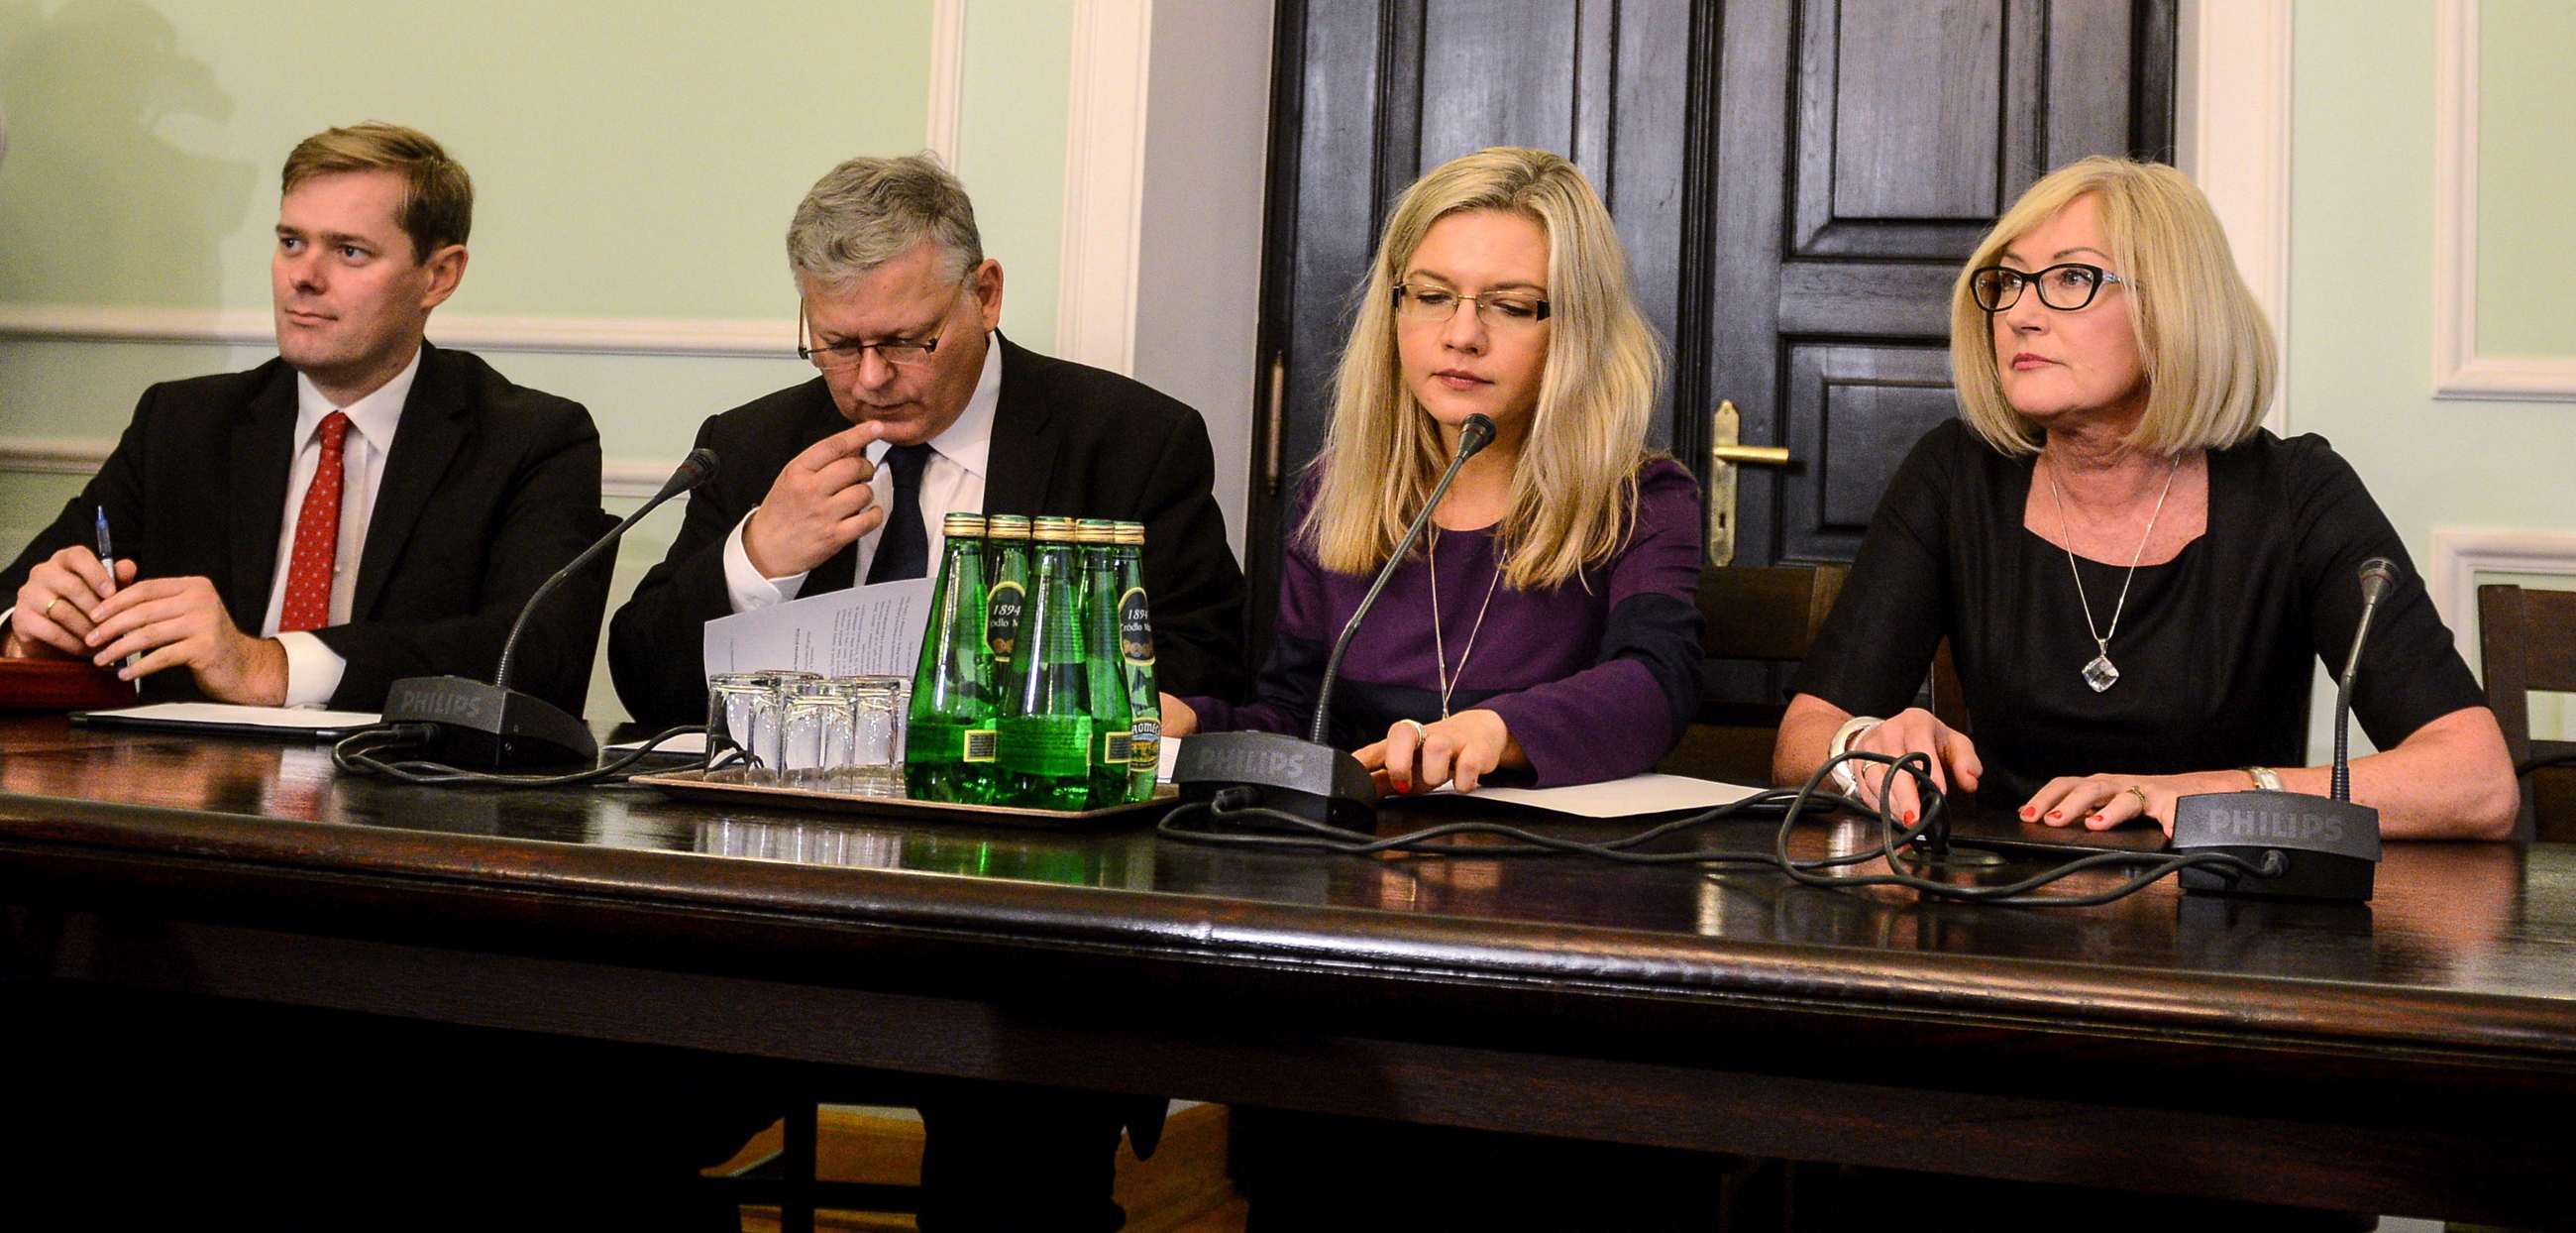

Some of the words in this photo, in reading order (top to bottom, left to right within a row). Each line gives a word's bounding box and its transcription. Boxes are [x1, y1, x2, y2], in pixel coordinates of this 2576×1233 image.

[994, 605, 1021, 616] 1894
[400, 691, 482, 719] PHILIPS
[1198, 746, 1305, 778] PHILIPS
[2208, 807, 2343, 841] PHILIPS
